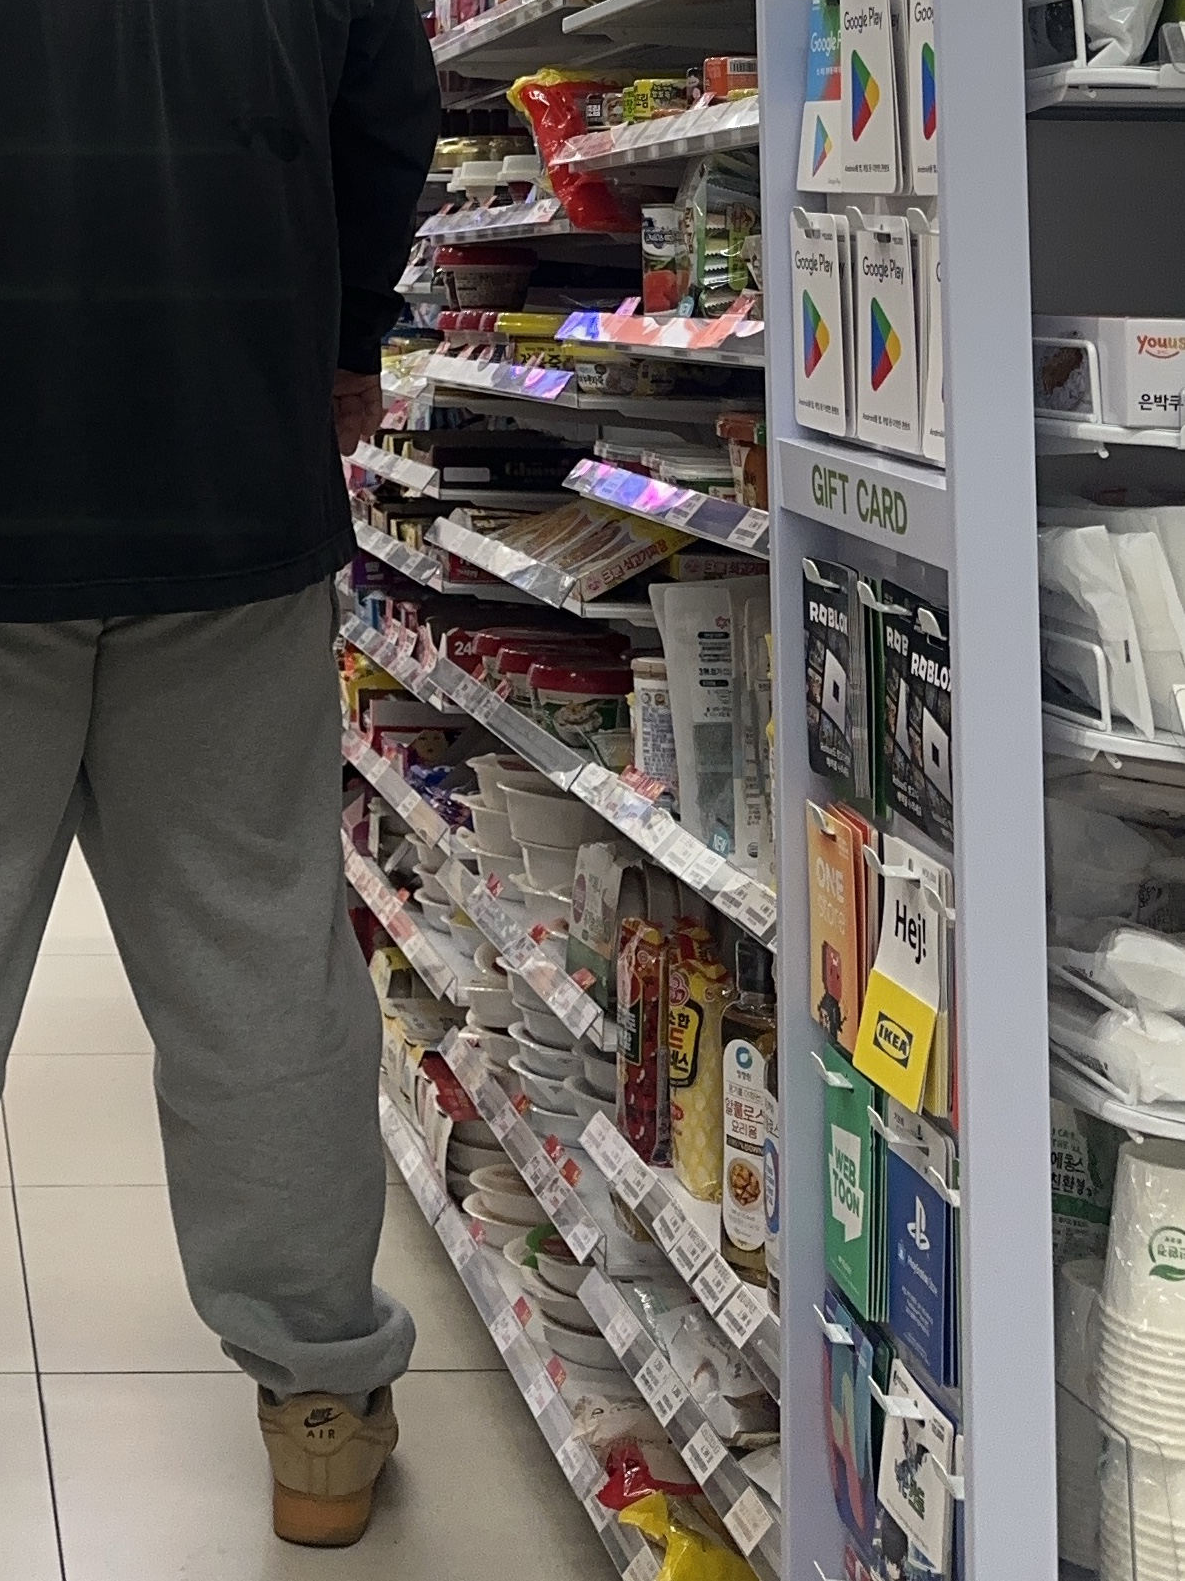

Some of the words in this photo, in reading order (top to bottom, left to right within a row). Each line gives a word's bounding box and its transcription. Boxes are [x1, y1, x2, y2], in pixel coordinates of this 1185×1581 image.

[844, 10, 868, 34] Google
[869, 6, 883, 30] Play
[810, 29, 837, 57] Google
[794, 250, 819, 277] Google
[819, 252, 834, 279] Play
[862, 256, 889, 283] Google
[889, 258, 905, 285] Play
[1138, 393, 1185, 412] 은박쿠
[811, 462, 849, 515] GIFT
[856, 477, 908, 536] CARD
[886, 625, 909, 657] ROB
[816, 856, 845, 904] ONE
[894, 899, 927, 965] Hej!
[878, 1022, 908, 1056] IKEA
[834, 1145, 857, 1189] WEB
[832, 1169, 861, 1219] TOON
[310, 1407, 333, 1421] NIKE
[307, 1428, 336, 1439] AIR
